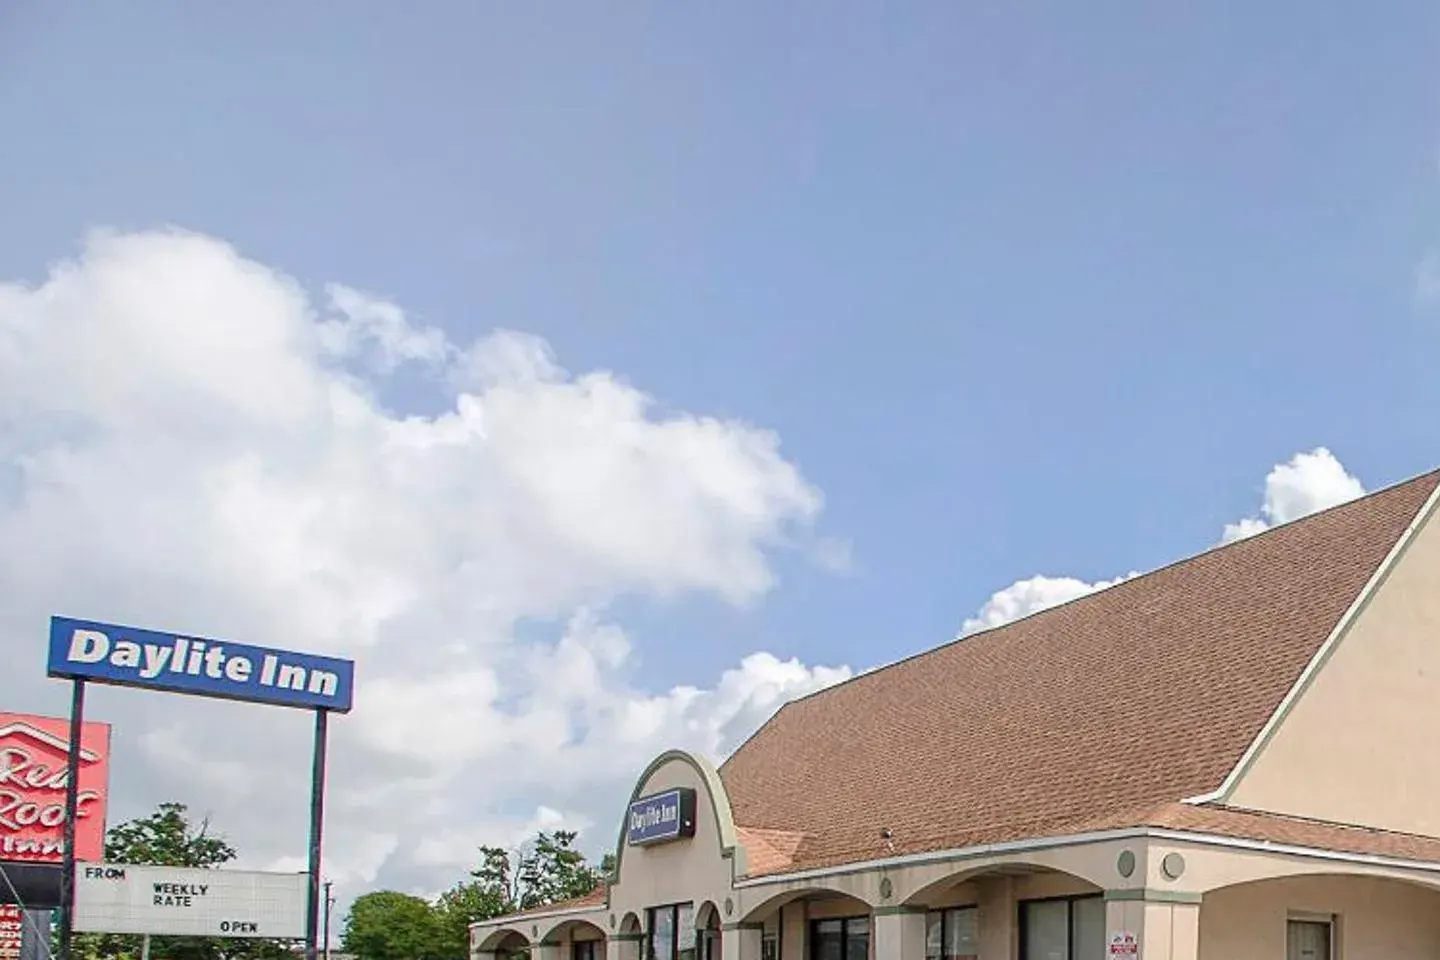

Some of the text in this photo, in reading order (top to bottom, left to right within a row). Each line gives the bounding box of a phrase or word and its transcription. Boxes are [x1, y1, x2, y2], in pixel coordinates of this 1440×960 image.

[67, 629, 338, 697] Daylite Inn
[85, 867, 125, 880] FROM
[153, 882, 208, 896] WEEKLY
[153, 896, 191, 907] RATE
[220, 921, 258, 933] OPEN
